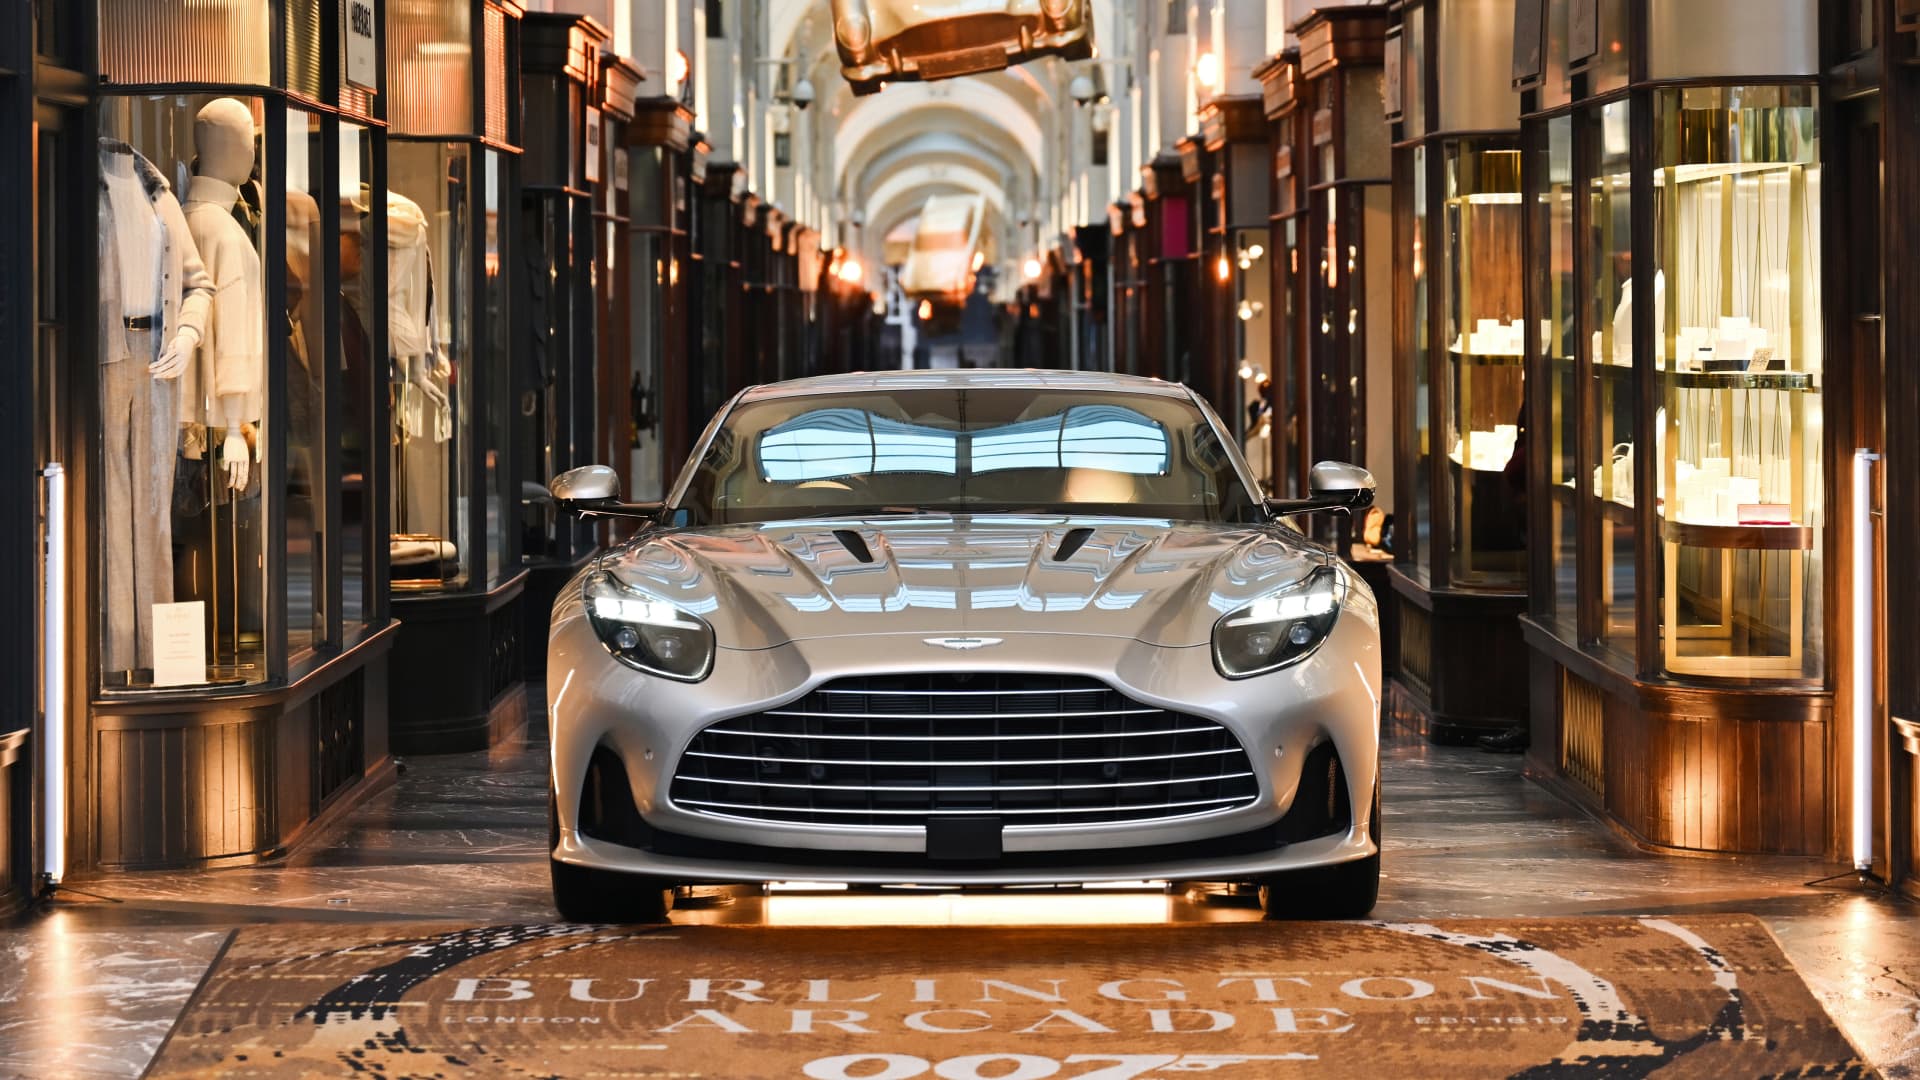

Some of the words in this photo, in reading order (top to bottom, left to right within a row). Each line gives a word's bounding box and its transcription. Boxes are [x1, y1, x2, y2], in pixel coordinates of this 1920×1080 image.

[449, 977, 1563, 1002] BURLINGTON
[443, 1015, 600, 1024] LONDON
[656, 1007, 1356, 1034] ARCADE
[802, 1053, 1182, 1080] 007
